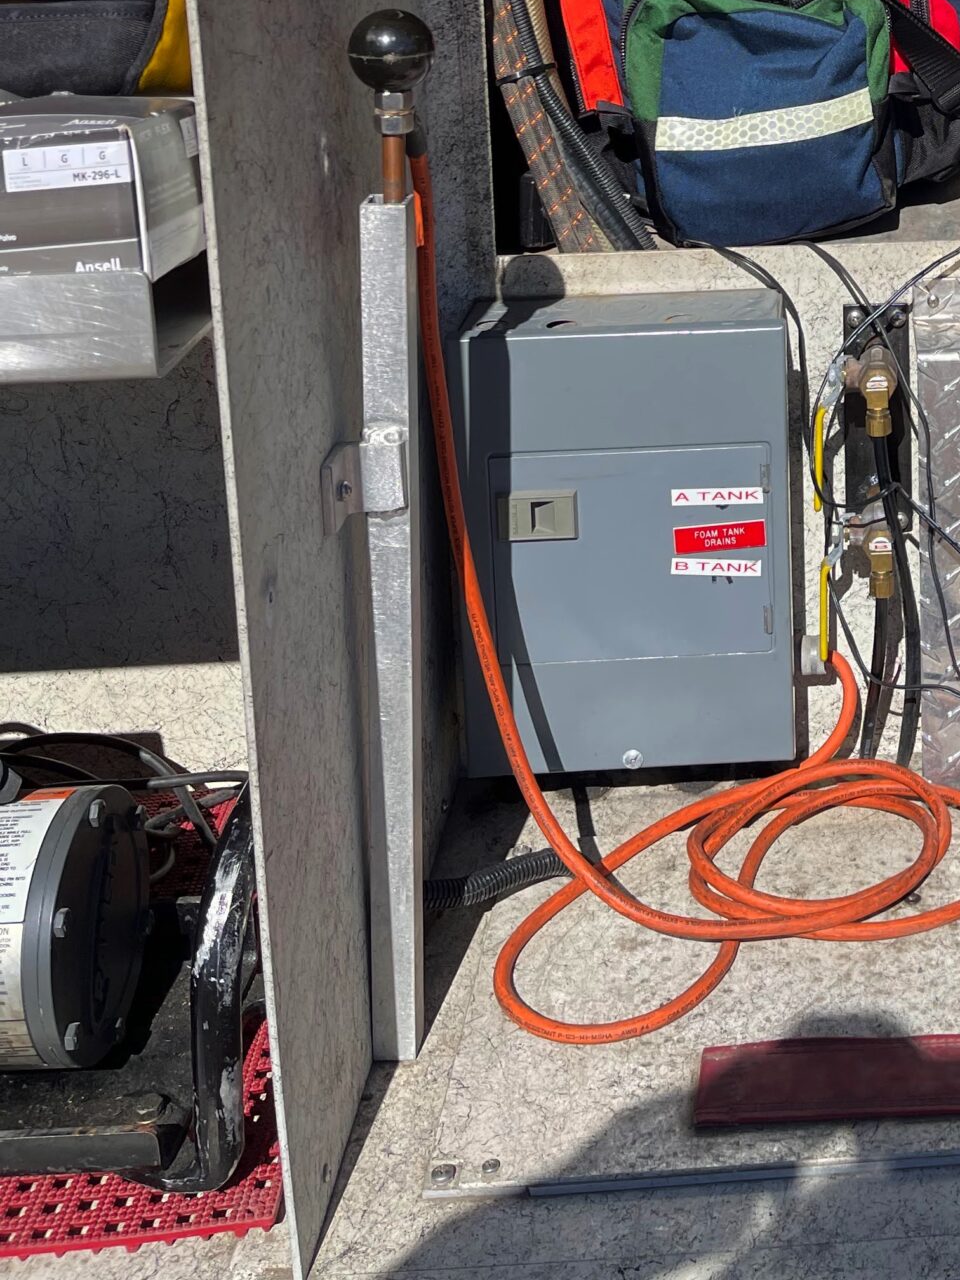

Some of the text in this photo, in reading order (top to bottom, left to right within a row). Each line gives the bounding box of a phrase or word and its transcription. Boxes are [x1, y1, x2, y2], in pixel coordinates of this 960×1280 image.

[60, 119, 117, 127] Ansell
[22, 150, 106, 167] L G G
[72, 170, 121, 182] MK-296-L
[75, 258, 122, 273] Ansell
[675, 490, 759, 502] A TANK
[694, 527, 746, 539] FOAM TANK
[704, 536, 737, 547] DRAINS
[675, 561, 757, 572] B TANK
